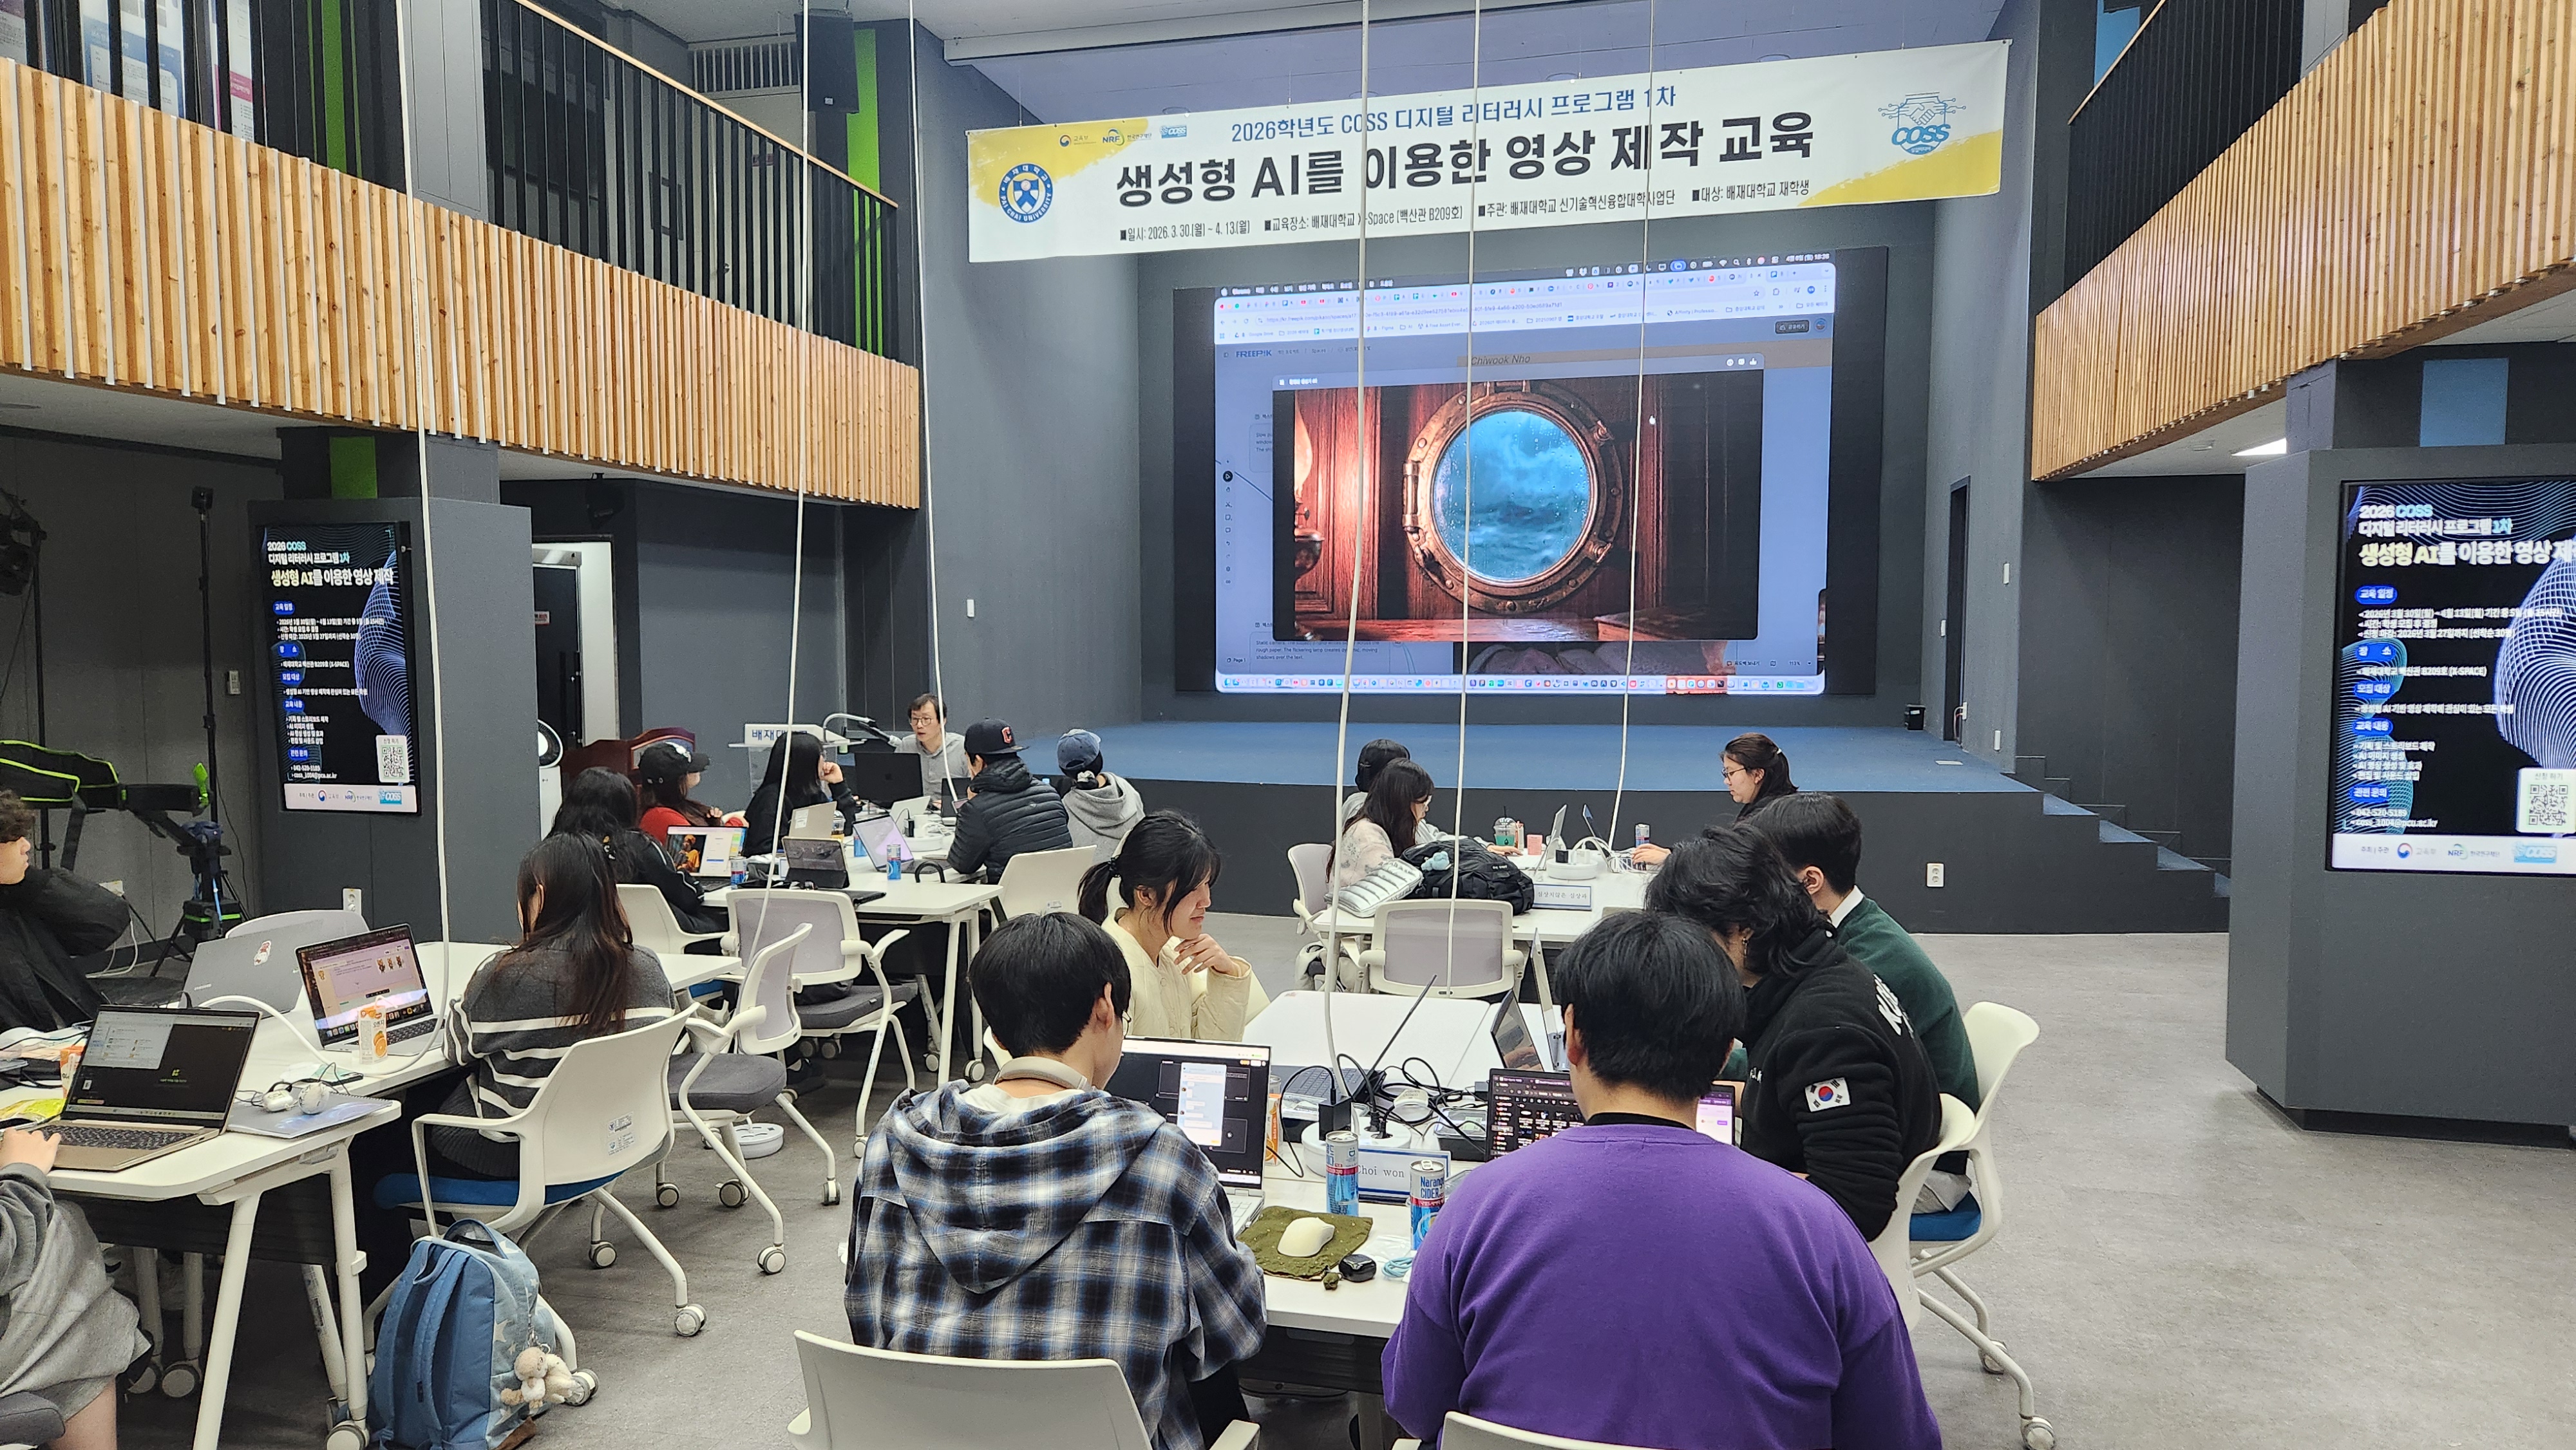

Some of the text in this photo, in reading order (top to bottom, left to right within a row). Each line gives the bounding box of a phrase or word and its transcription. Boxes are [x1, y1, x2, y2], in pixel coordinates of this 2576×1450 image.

[1232, 86, 1676, 142] 2026학년도 COSS 디지털 리터러시 프로그램 1차
[1168, 126, 1187, 135] COSS
[1891, 124, 1951, 146] COSS
[1117, 111, 1813, 208] 생성형 AI를 이용한 영상 제작 교육
[1701, 179, 1810, 202] 대상: 배재대학교 재학생
[1000, 193, 1052, 222] PAI CHAI UNIVERSITY
[1486, 189, 1676, 218] 주관: 배재대학교 신기술혁신융합대학사업단
[1311, 212, 1355, 229] 배재대학교
[1397, 207, 1426, 224] (백산관
[1428, 205, 1463, 221] B209호)
[1148, 226, 1170, 240] 2026.
[1171, 226, 1178, 238] 3.
[1215, 222, 1222, 235] 4.
[1236, 350, 1273, 358] FREEPIK
[1471, 355, 1531, 365] Chiwook Nho
[2359, 504, 2434, 519] 2026 COSS
[2358, 517, 2514, 538] 디지털 리터러시 프로그램 1차
[267, 541, 307, 552] 2026 COSS
[2358, 538, 2576, 567] 생성형 AI를 이용한 영상 제
[268, 552, 288, 565] 디지털
[288, 552, 314, 565] 리터러시
[314, 552, 339, 565] 프로그램
[271, 567, 394, 587] 생성형 AI를 이용한 영상 제작
[2360, 588, 2376, 599] 교육
[1001, 726, 1013, 744] C
[1383, 1168, 1405, 1178] won
[1420, 1176, 1444, 1189] Narang
[1420, 1187, 1439, 1199] CIDER
